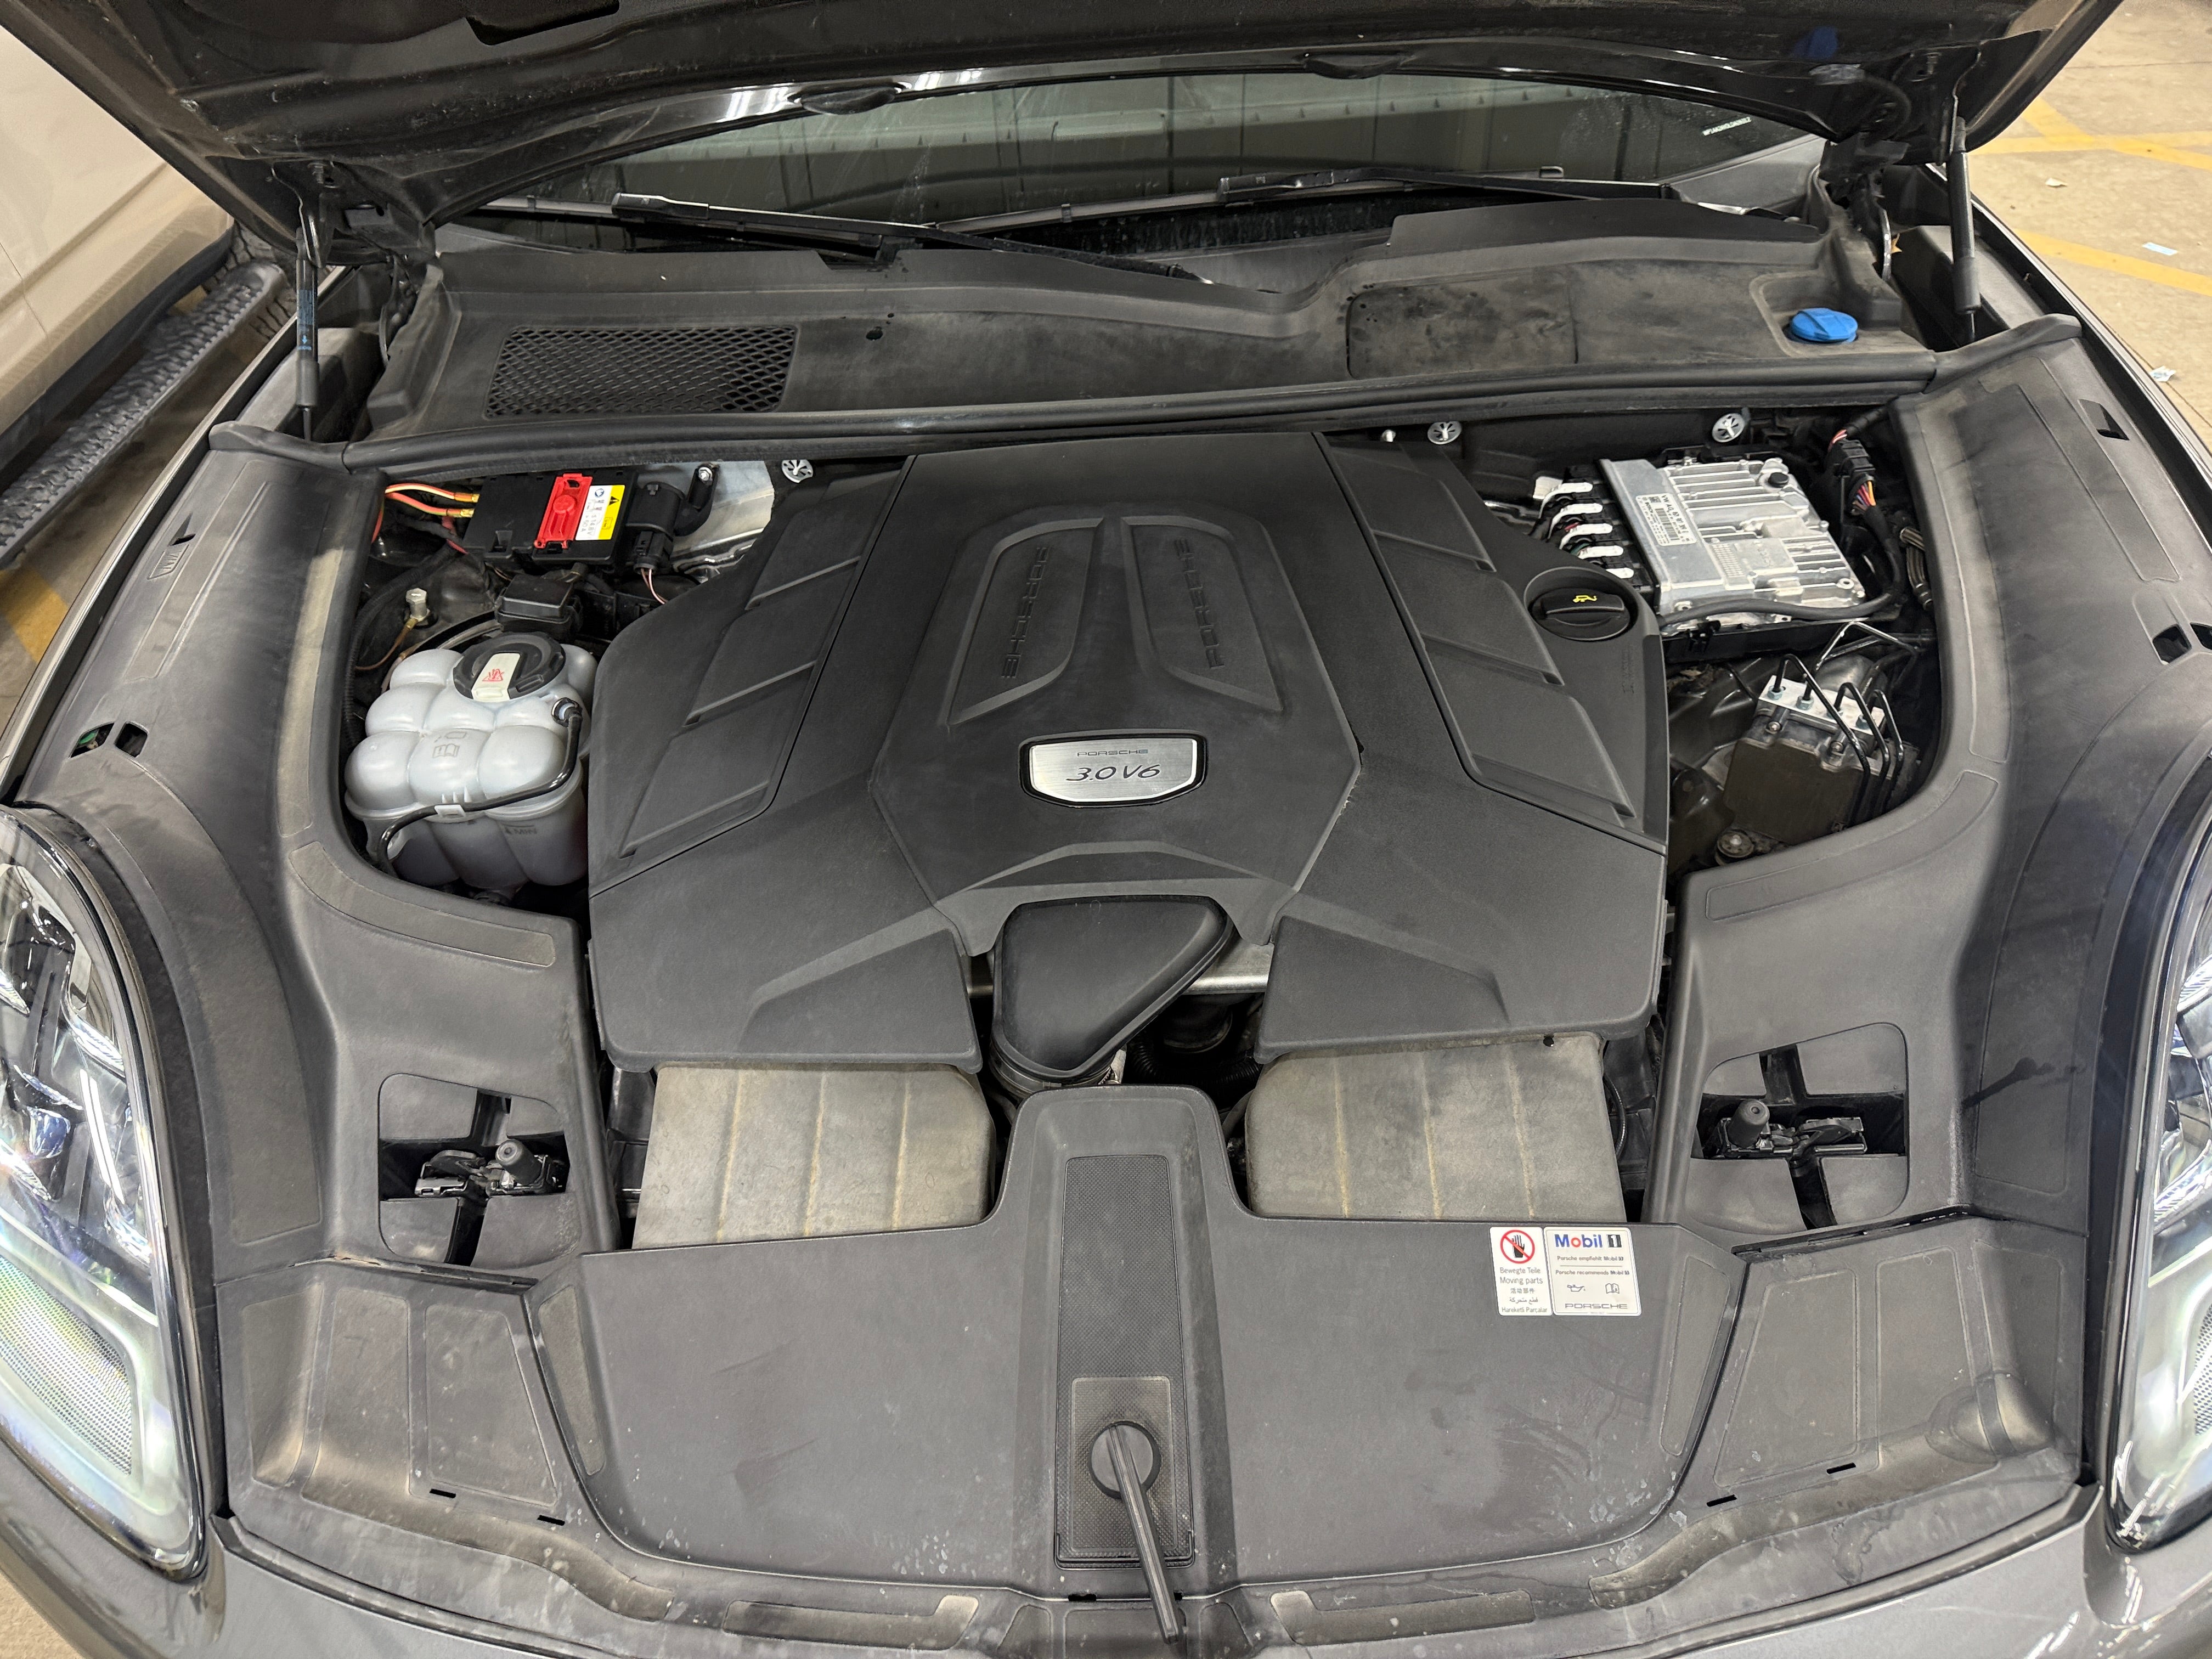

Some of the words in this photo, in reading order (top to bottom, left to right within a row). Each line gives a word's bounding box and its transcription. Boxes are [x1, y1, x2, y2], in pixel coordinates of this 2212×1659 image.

[1173, 538, 1226, 670] PORSCHE
[1001, 546, 1050, 679] PORSCHE
[1065, 767, 1116, 781] 3.0
[1122, 764, 1161, 780] V6
[1554, 1234, 1603, 1248] Mobil
[1608, 1234, 1618, 1248] 1
[1499, 1267, 1526, 1275] Bewegte
[1499, 1277, 1524, 1285] Moving
[1526, 1277, 1543, 1285] parts
